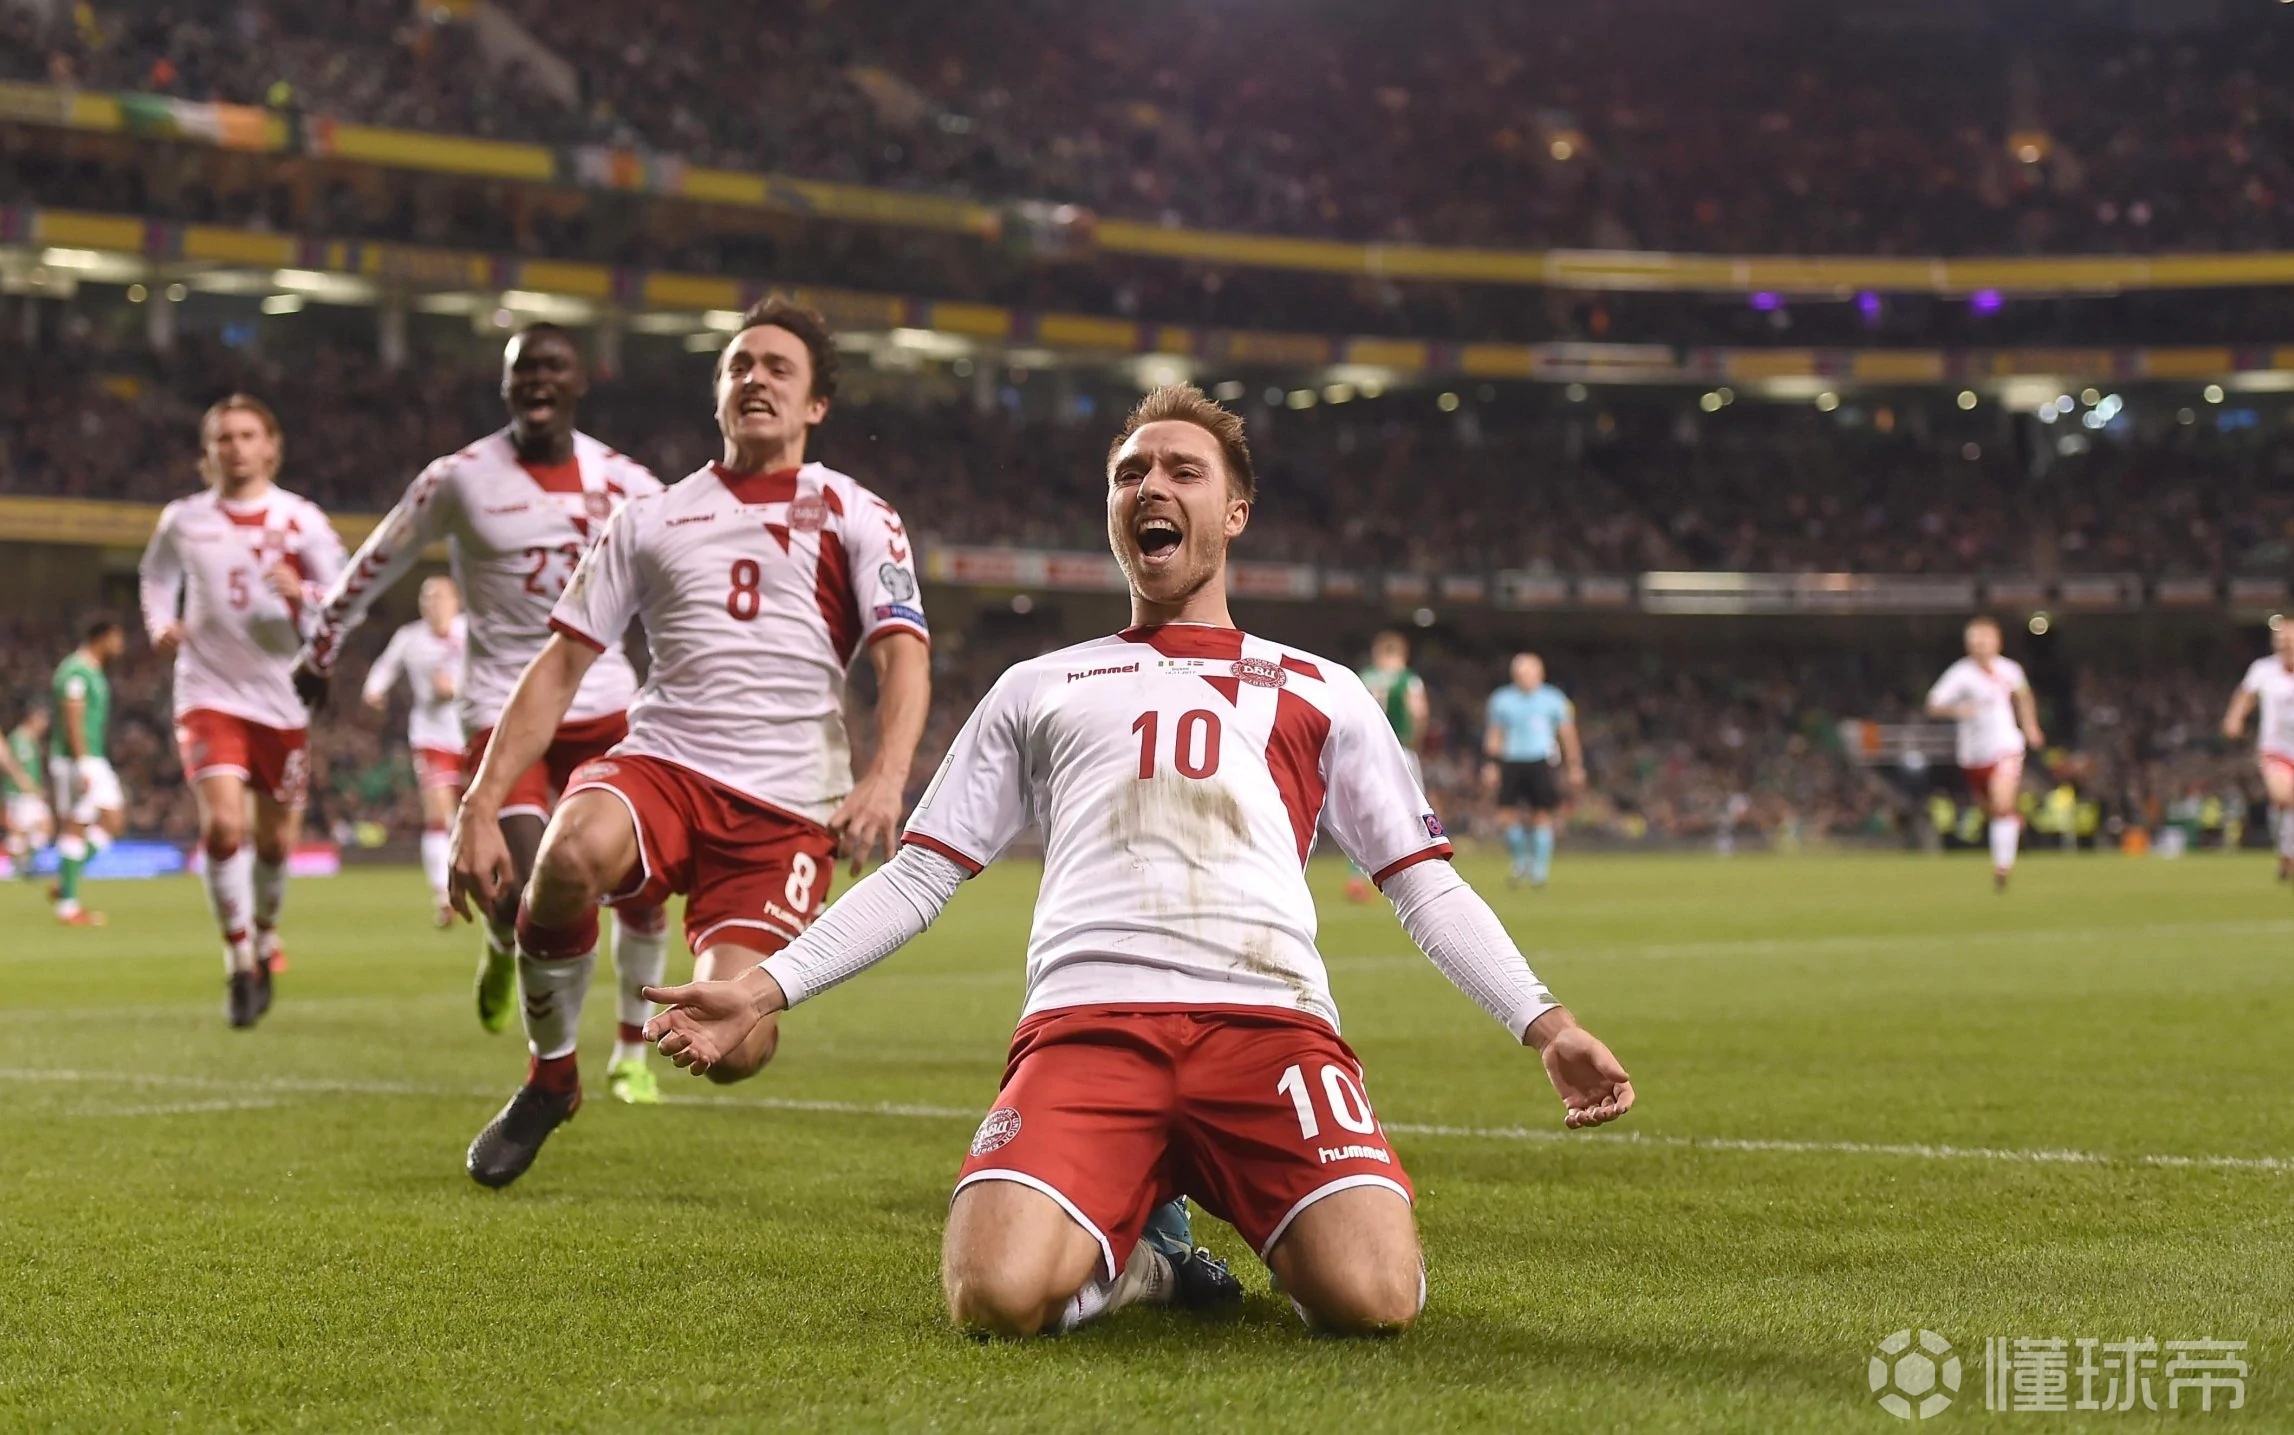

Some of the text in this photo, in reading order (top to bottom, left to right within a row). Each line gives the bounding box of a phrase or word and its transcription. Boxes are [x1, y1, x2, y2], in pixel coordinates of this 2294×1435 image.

[229, 568, 248, 610] 5
[727, 558, 761, 621] 8
[1067, 662, 1140, 683] hummel
[1242, 665, 1276, 679] DBU
[1132, 708, 1222, 780] 10
[784, 851, 817, 914] 8
[1277, 1064, 1375, 1140] 10
[1318, 1145, 1391, 1164] hummel
